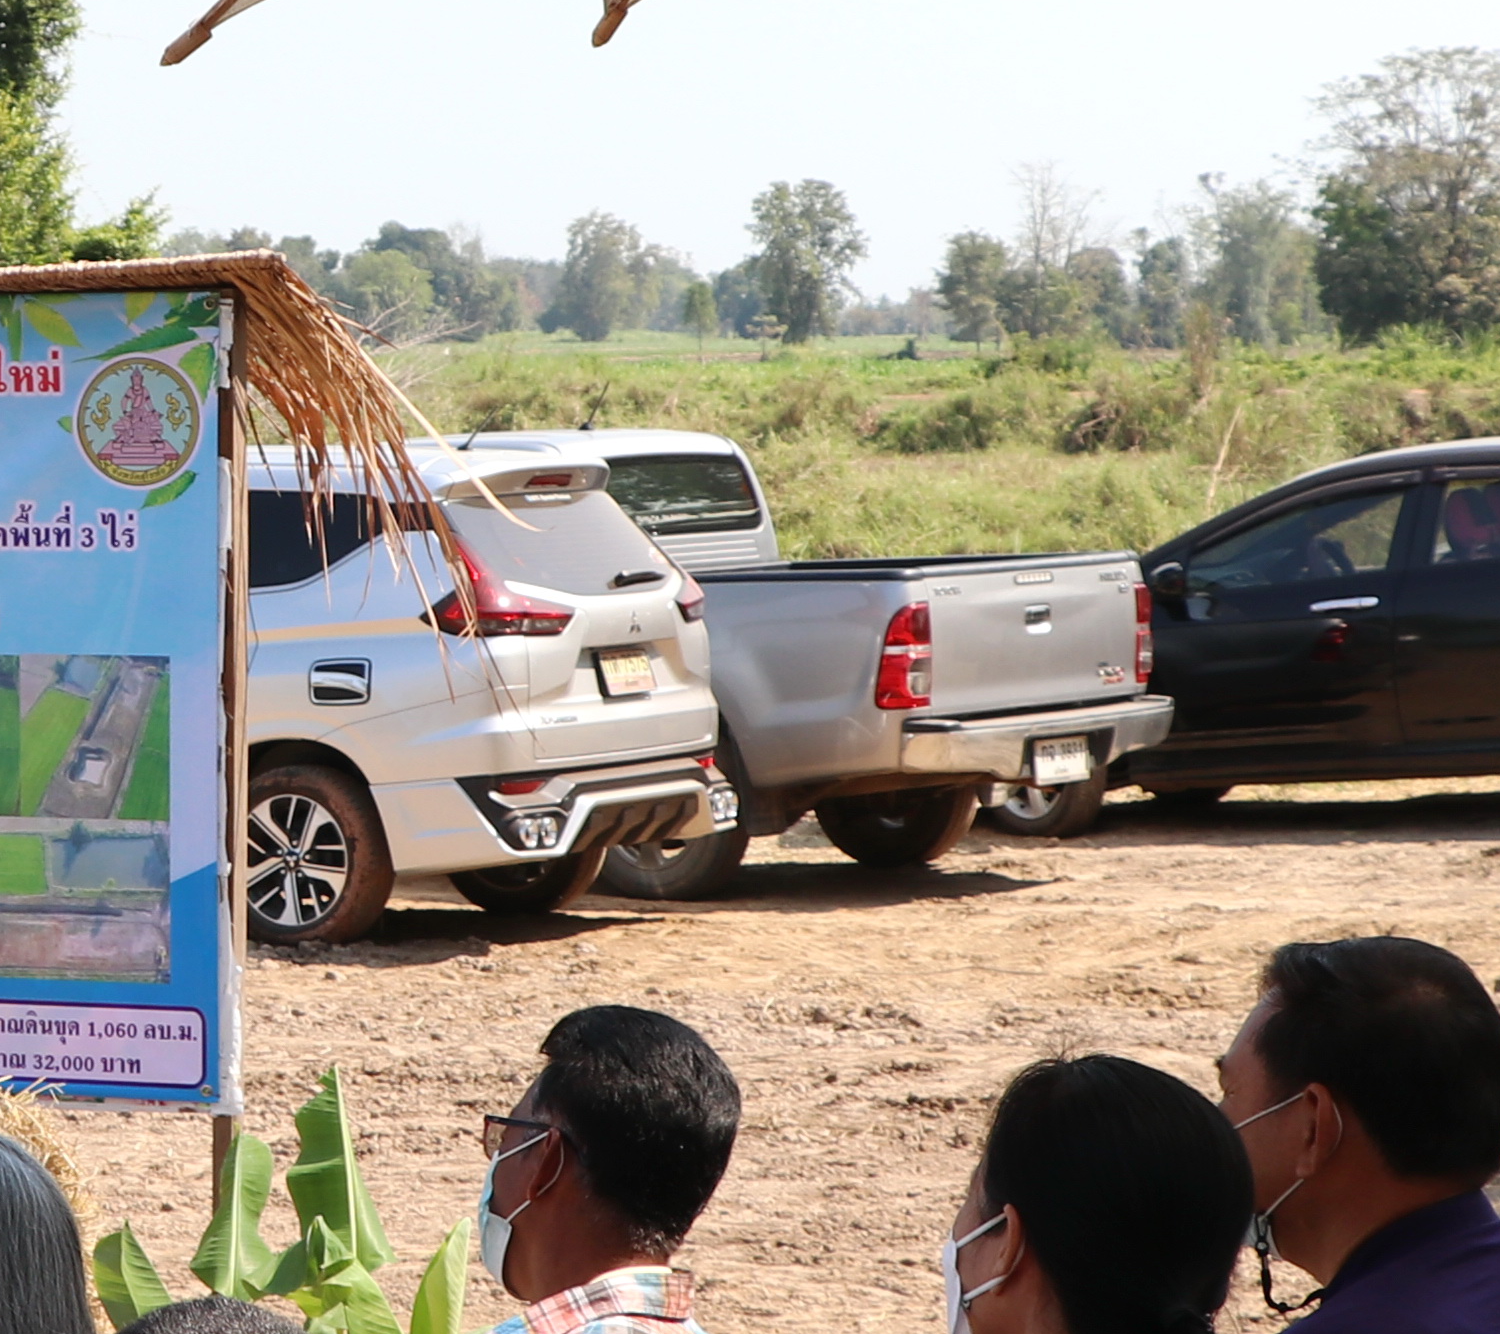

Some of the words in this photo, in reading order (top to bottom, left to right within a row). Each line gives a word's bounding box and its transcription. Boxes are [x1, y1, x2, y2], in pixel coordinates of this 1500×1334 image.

[80, 526, 95, 548] 3
[100, 509, 136, 549] ไร่
[88, 1021, 137, 1039] 1,060
[144, 1023, 198, 1042] ลบ.ม.
[33, 1054, 94, 1073] 32,000
[101, 1056, 141, 1075] บาท
